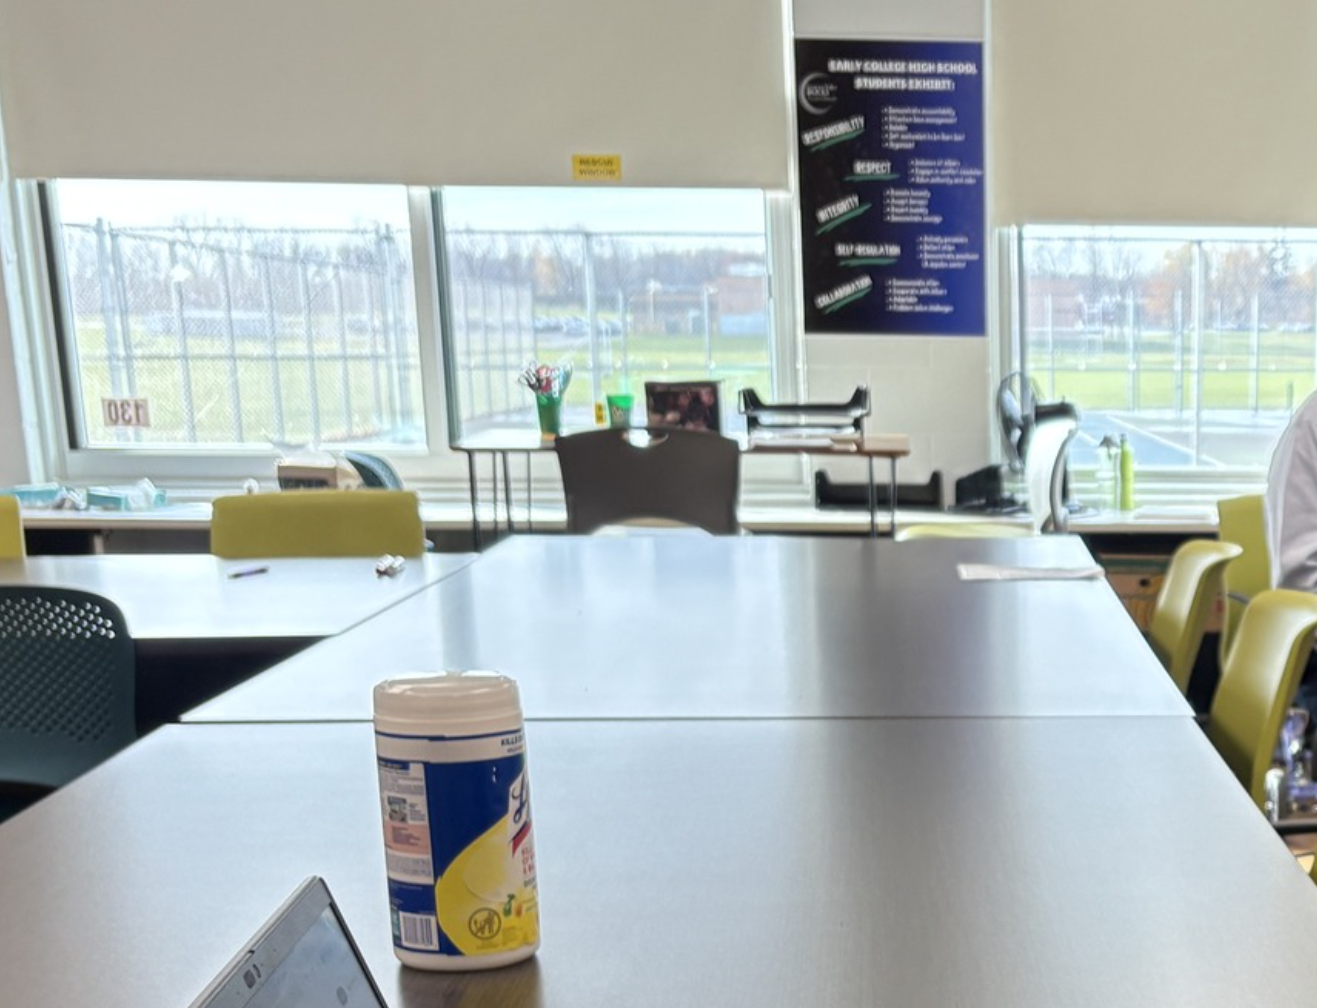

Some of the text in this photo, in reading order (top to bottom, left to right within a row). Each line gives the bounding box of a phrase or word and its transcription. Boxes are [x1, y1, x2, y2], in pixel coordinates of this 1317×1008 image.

[828, 59, 978, 75] EARLY COLLEGE HIGH SCHOOL
[854, 76, 906, 90] STUDENTS
[802, 115, 864, 146] RESPONSIBILITY
[854, 159, 891, 174] RESPECT
[815, 194, 860, 224] INTEGRITY
[814, 274, 873, 309] COLLABORATION
